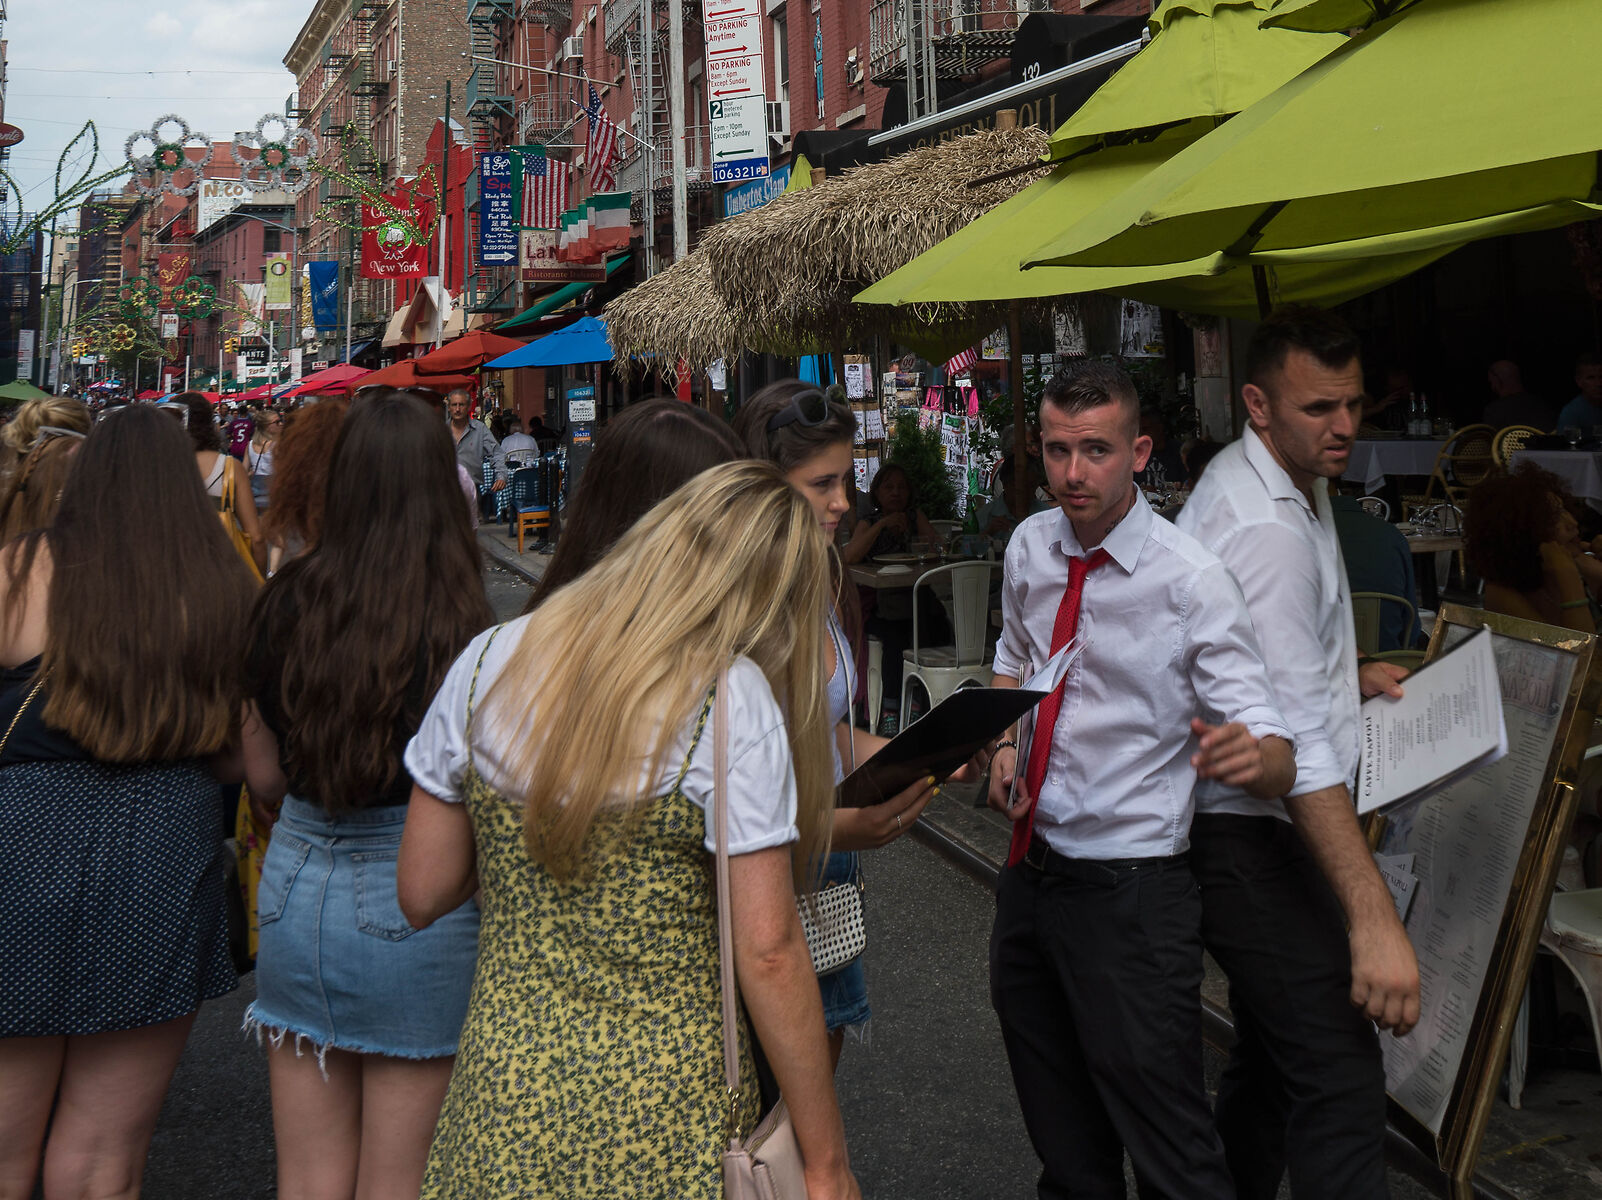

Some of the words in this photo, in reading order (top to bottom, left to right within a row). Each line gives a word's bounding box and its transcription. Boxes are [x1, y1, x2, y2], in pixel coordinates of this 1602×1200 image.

[708, 24, 717, 32] NO
[719, 19, 748, 31] PARKING
[709, 32, 736, 43] Anytime
[710, 62, 720, 71] NO
[721, 58, 751, 69] PARKING
[711, 72, 722, 80] 8am
[726, 70, 738, 78] 6pm
[711, 79, 728, 87] Except
[729, 77, 748, 85] Sunday
[712, 101, 722, 118] 2
[724, 111, 741, 119] parking
[714, 124, 725, 132] 6pm
[729, 122, 743, 130] 10pm
[714, 131, 731, 140] Except
[732, 129, 751, 137] Sunday
[714, 166, 754, 181] 106321
[764, 176, 785, 201] Clam
[369, 260, 396, 275] New
[397, 260, 420, 273] York
[528, 270, 569, 279] Ristorante
[241, 350, 265, 358] DANTE
[237, 429, 245, 443] 5
